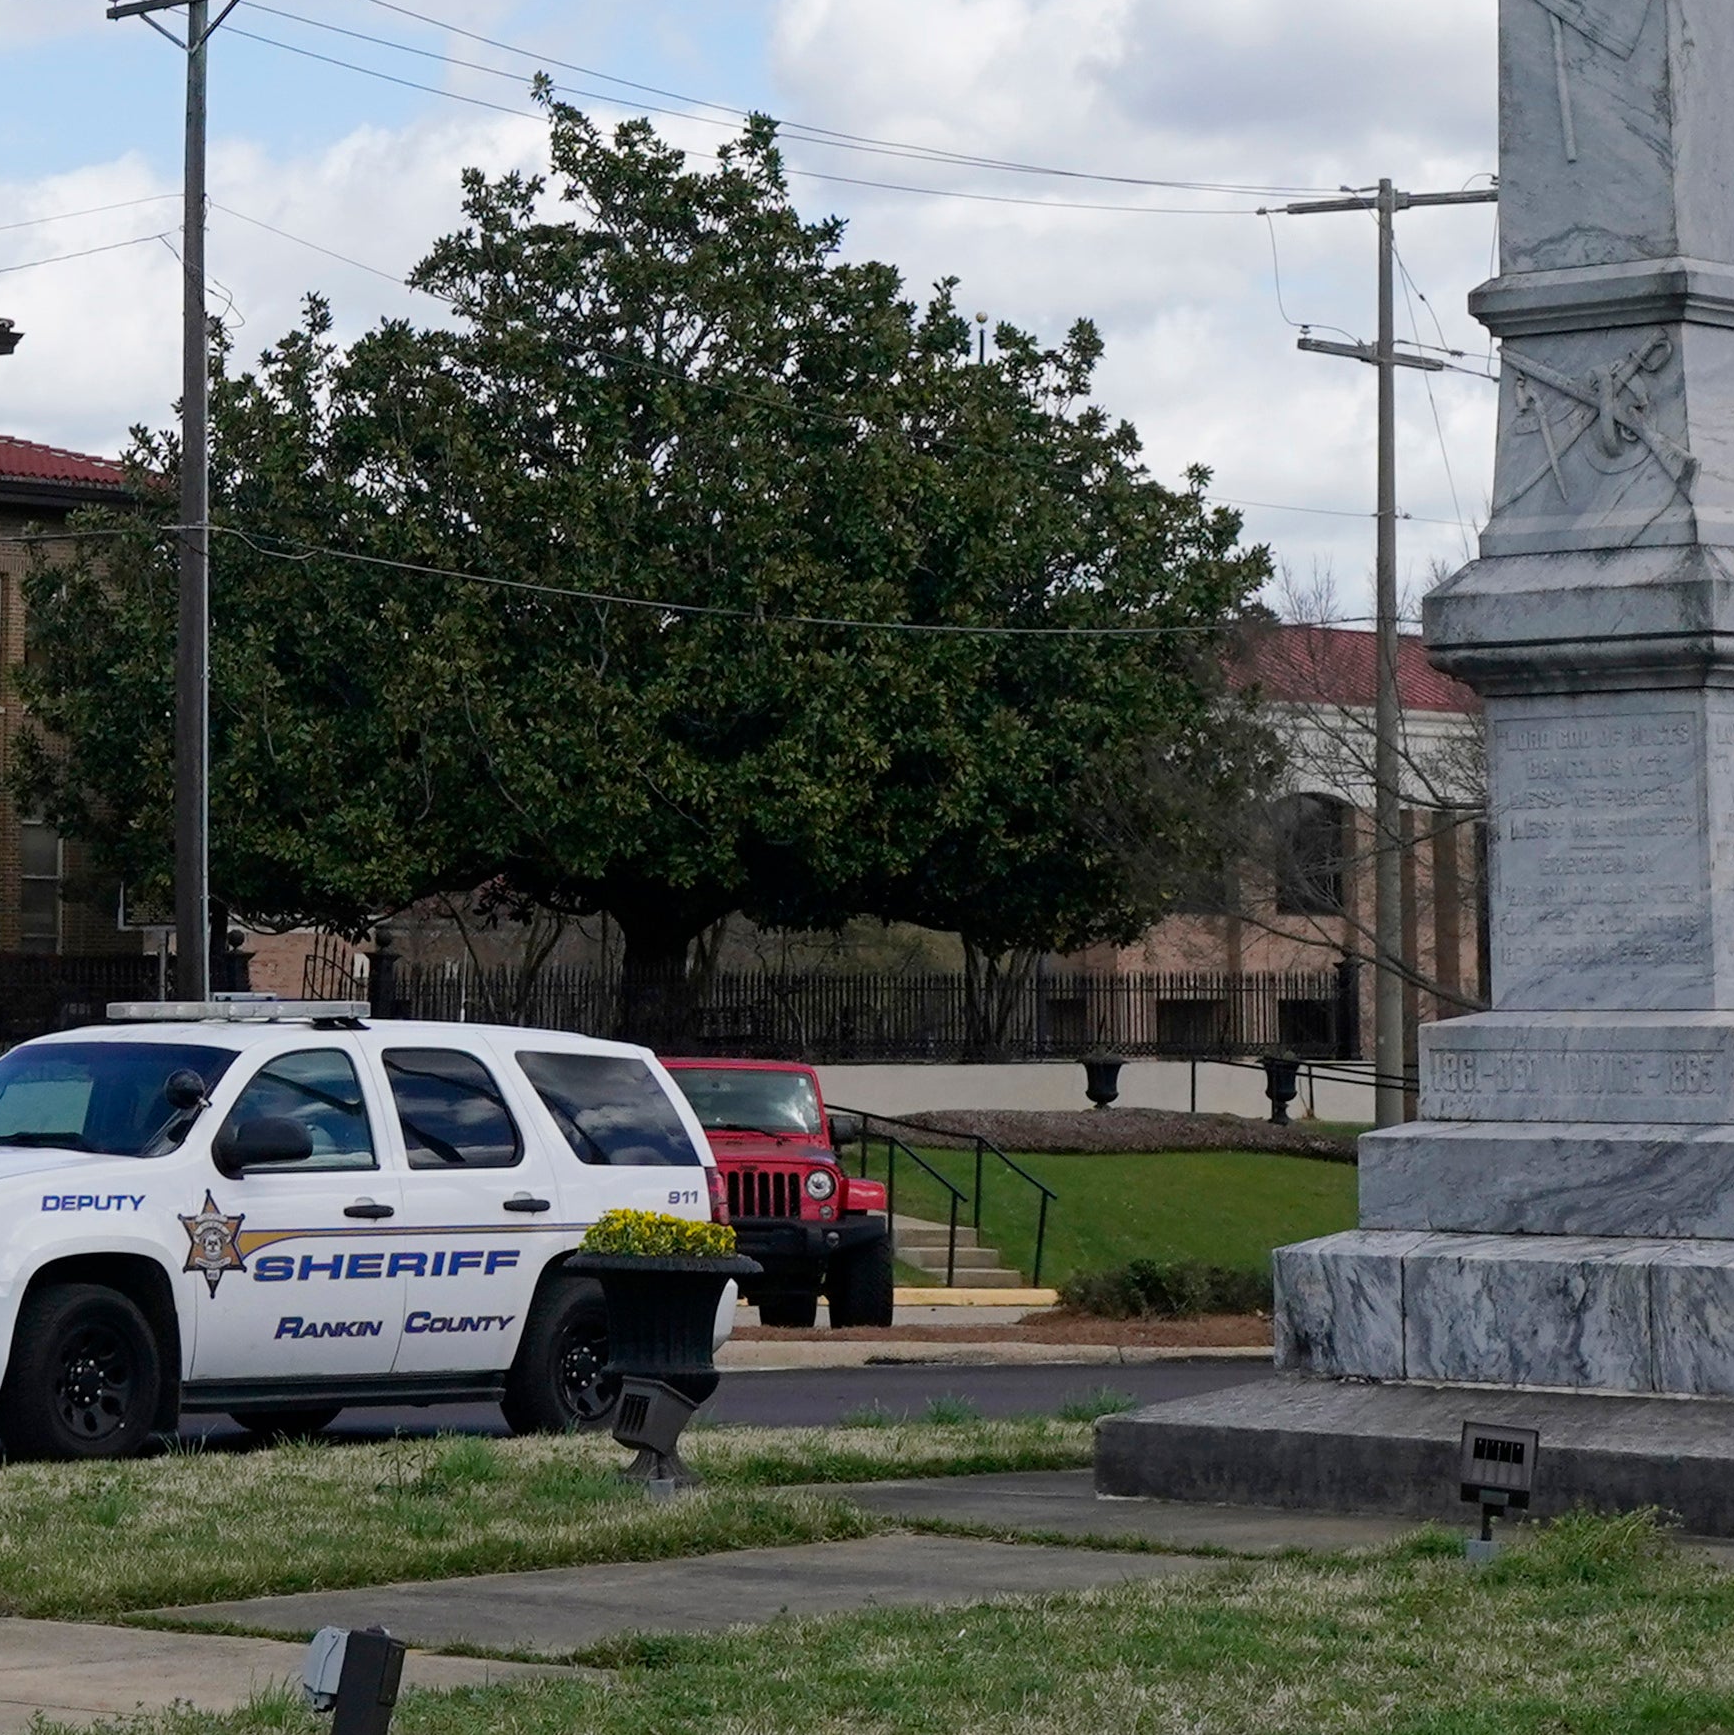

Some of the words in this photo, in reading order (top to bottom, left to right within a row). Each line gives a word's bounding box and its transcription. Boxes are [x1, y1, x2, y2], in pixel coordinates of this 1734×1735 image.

[41, 1195, 146, 1211] DEPUTY
[668, 1190, 698, 1204] 911
[253, 1250, 520, 1282] SHERIFF
[274, 1316, 383, 1339] RANKIN
[404, 1311, 515, 1334] COUNTY
